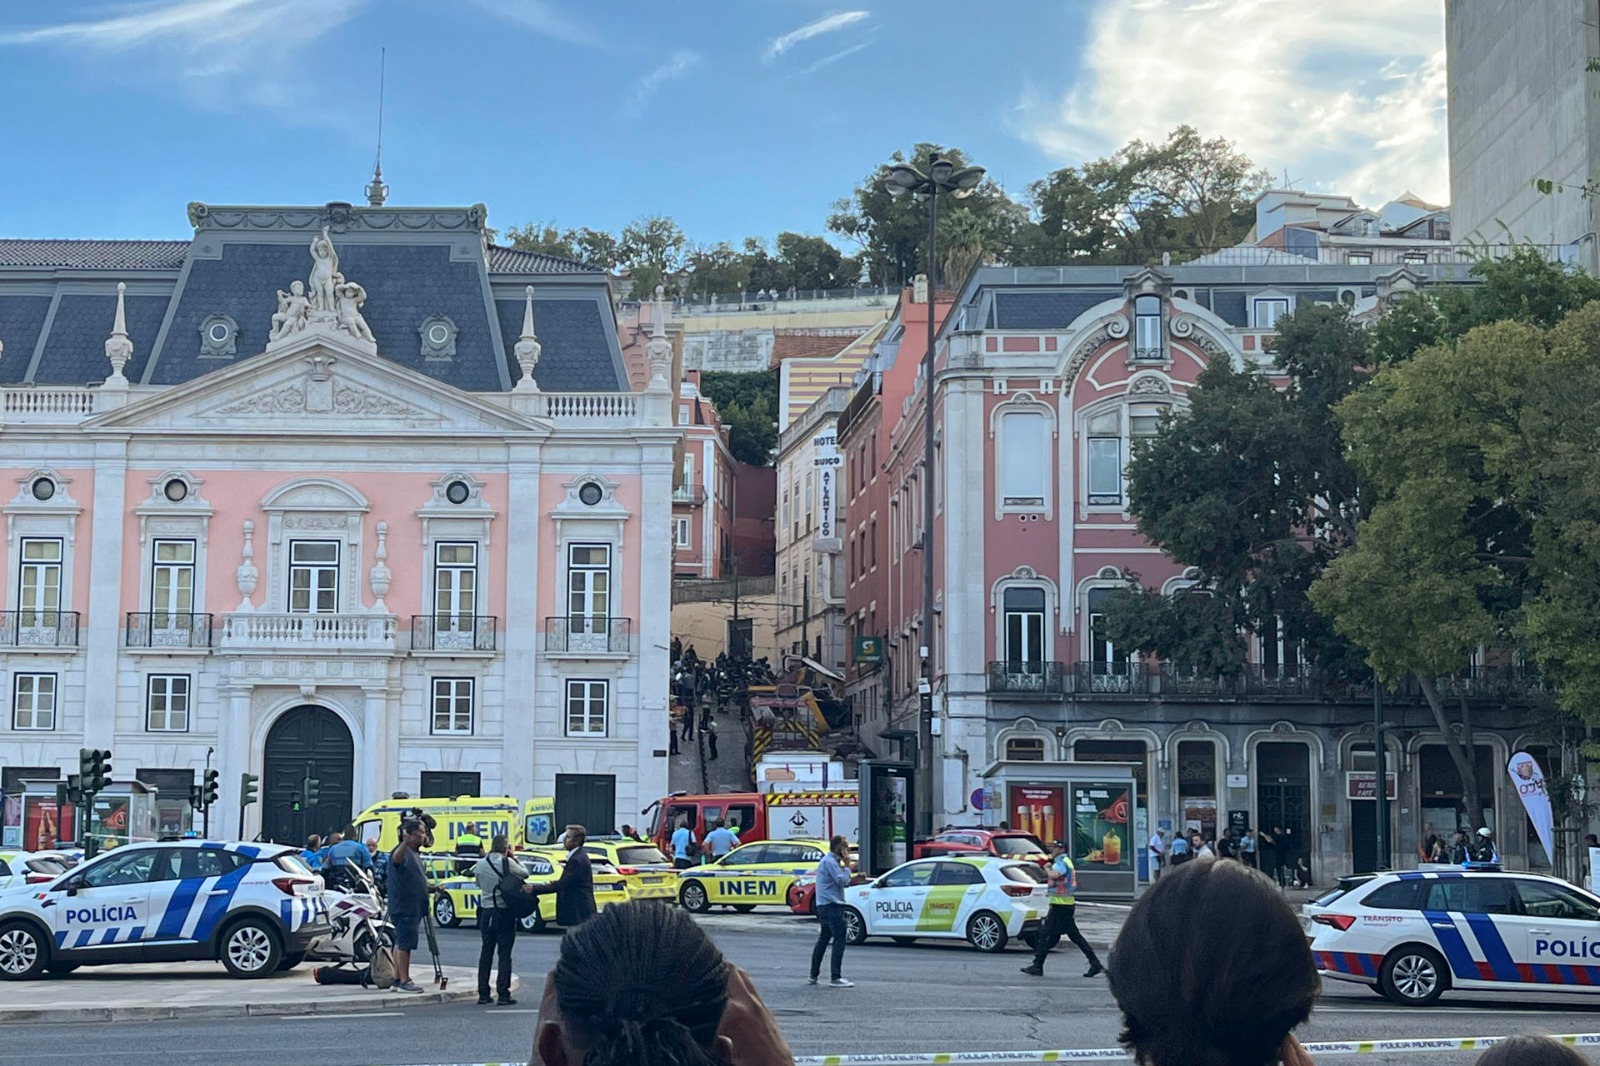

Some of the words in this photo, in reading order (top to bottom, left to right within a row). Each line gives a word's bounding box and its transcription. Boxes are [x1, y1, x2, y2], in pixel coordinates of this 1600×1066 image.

[719, 881, 776, 896] INEM
[876, 900, 914, 912] POLÍCIA
[66, 904, 137, 924] POLÍCIA
[1363, 914, 1402, 922] TRÂNSITO
